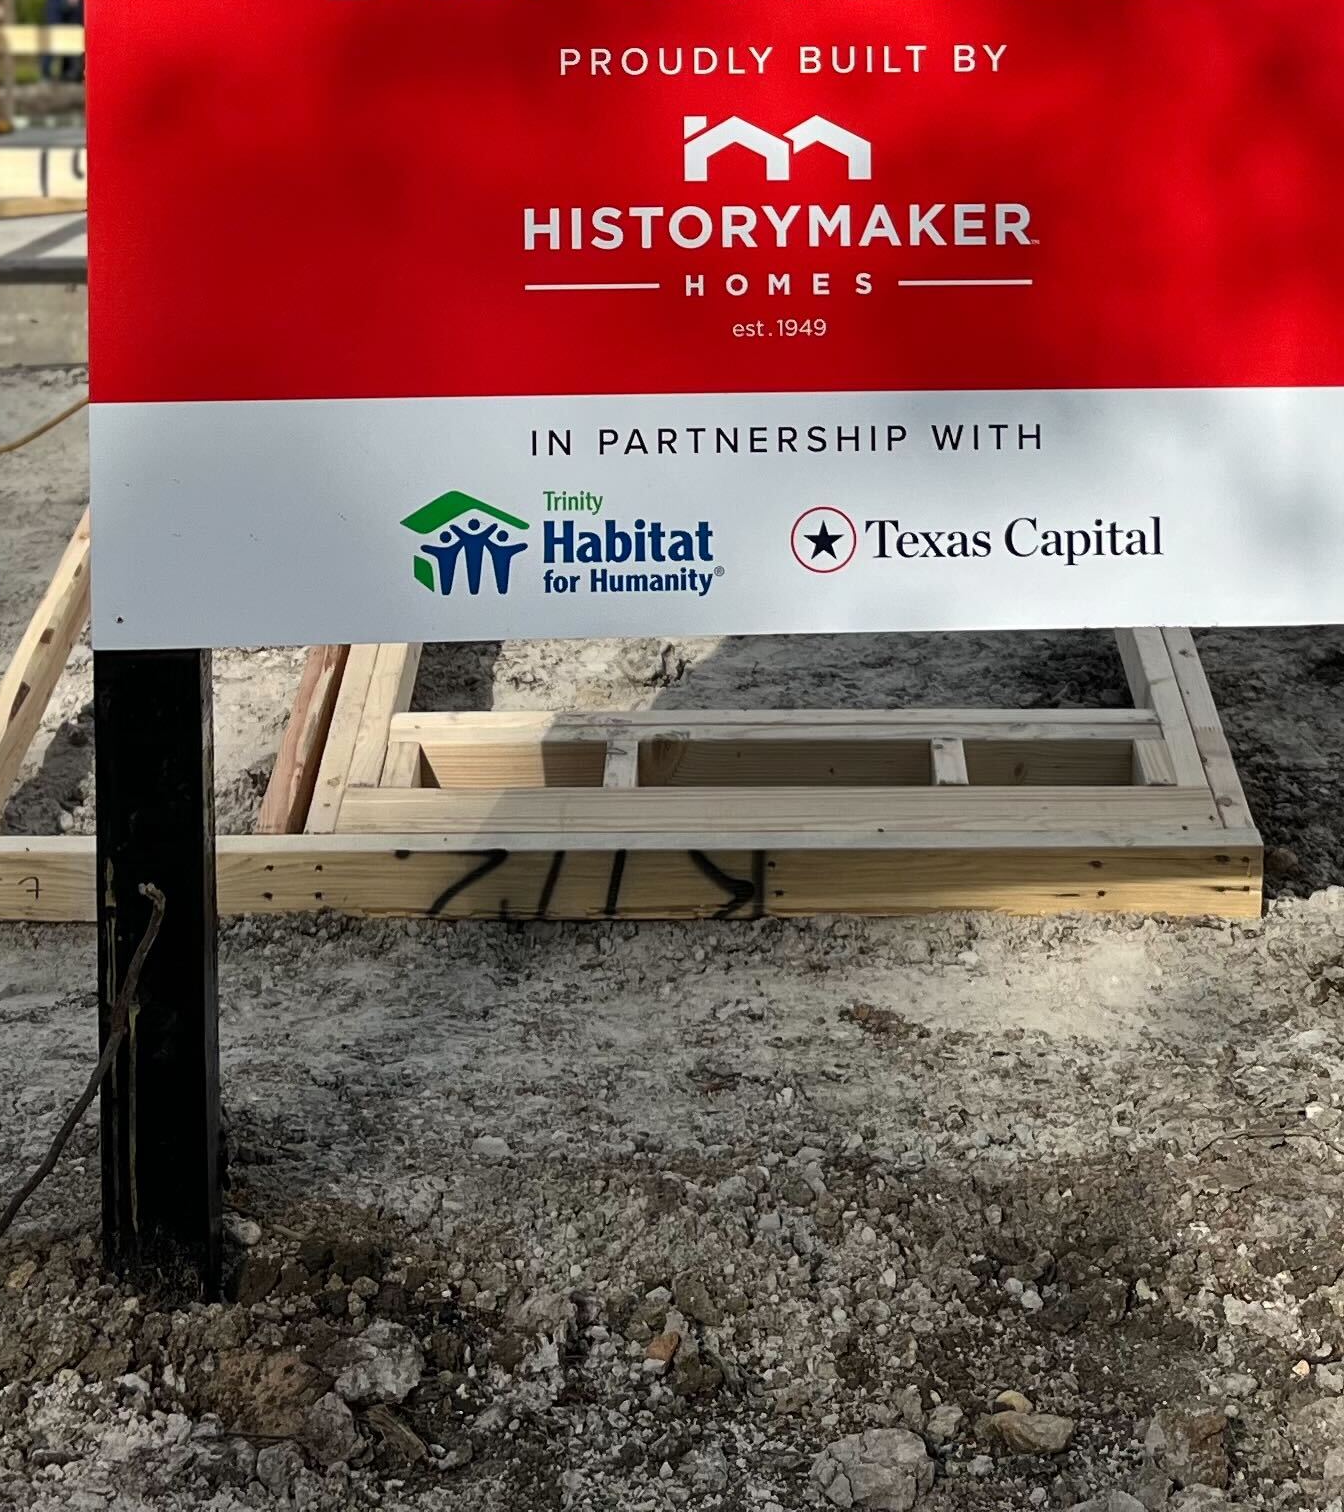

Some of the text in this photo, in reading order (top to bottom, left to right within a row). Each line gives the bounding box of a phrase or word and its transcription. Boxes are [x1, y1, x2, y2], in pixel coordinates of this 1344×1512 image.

[560, 44, 1008, 76] PROUDLY BUILT BY
[684, 272, 874, 297] HOMES
[531, 422, 1043, 457] IN PARTNERSHIP WITH
[542, 490, 604, 516] Trinity
[543, 518, 714, 564] Habitat
[864, 515, 1164, 567] Texas Capital
[542, 568, 581, 594] for
